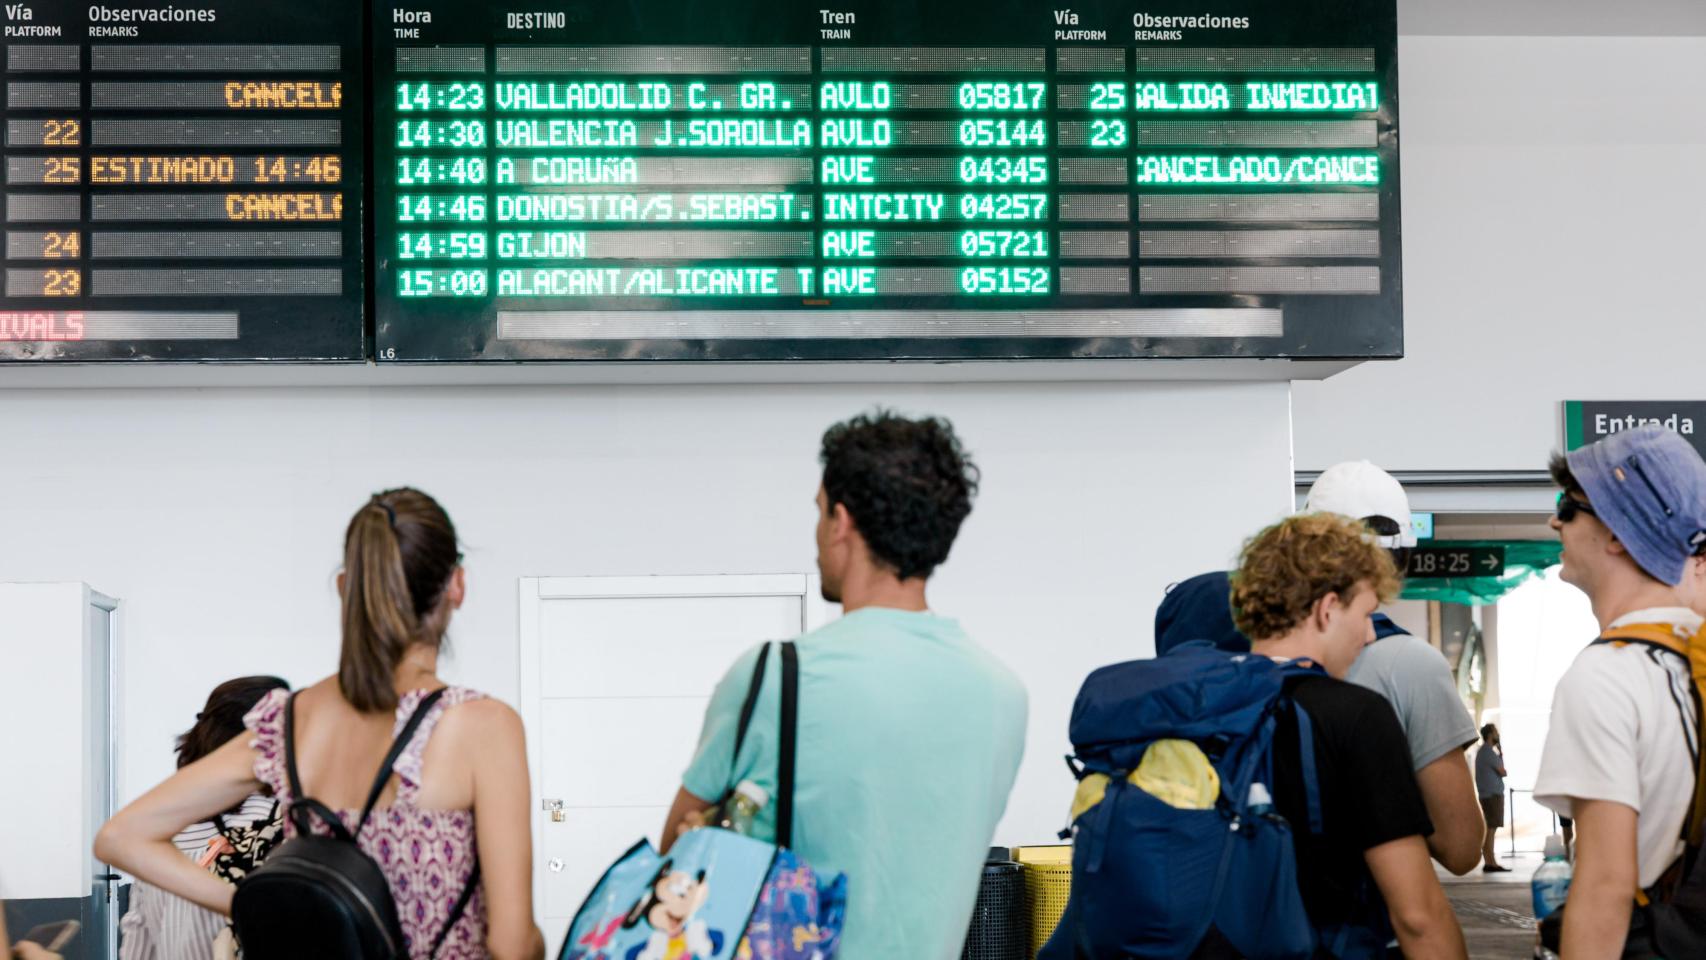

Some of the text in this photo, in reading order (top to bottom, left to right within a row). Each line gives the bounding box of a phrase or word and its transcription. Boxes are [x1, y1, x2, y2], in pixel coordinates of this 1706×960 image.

[5, 4, 33, 21] Vía
[88, 6, 216, 22] Observaciones
[393, 8, 432, 23] Hora
[507, 12, 565, 29] DESTINO
[820, 9, 856, 24] Tren
[1054, 10, 1079, 25] Vía
[1133, 13, 1250, 29] Observaciones
[5, 26, 61, 37] PLATFORM
[88, 26, 138, 37] REMARKS
[394, 28, 420, 38] TIME
[821, 29, 851, 39] TRAIN
[1055, 30, 1106, 40] PLATFORM
[1134, 31, 1183, 41] REMARKS
[397, 83, 485, 110] 14:23
[496, 83, 791, 110] VALLADOLID C. GR.
[821, 83, 890, 110] AVLO
[959, 83, 1045, 110] 05817
[1090, 83, 1125, 110] 25
[43, 120, 79, 146] 22
[397, 120, 486, 147] 14:30
[496, 120, 811, 147] VALENCIA J.SOROLLA
[821, 120, 891, 146] AVLO
[959, 120, 1046, 146] 05144
[1091, 120, 1126, 146] 23
[43, 158, 79, 183] 25
[91, 157, 340, 183] ESTIMADO 14:46
[398, 157, 486, 184] 14:40
[498, 157, 637, 184] A CORUÑA
[822, 156, 874, 183] AVE
[960, 156, 1047, 183] 04345
[398, 194, 486, 221] 14:46
[497, 194, 809, 221] DONOSTIA/S.SEBAST.
[824, 194, 943, 220] INTCITY
[960, 194, 1047, 220] 04257
[43, 232, 79, 258] 24
[398, 232, 486, 259] 14:59
[498, 232, 587, 259] GIJON
[823, 231, 875, 257] AVE
[961, 231, 1048, 257] 05721
[43, 270, 80, 296] 23
[399, 270, 487, 297] 15:00
[498, 268, 813, 296] ALACANT/ALICANTE T
[823, 268, 876, 294] AVE
[961, 267, 1048, 293] 05152
[380, 347, 395, 359] L6
